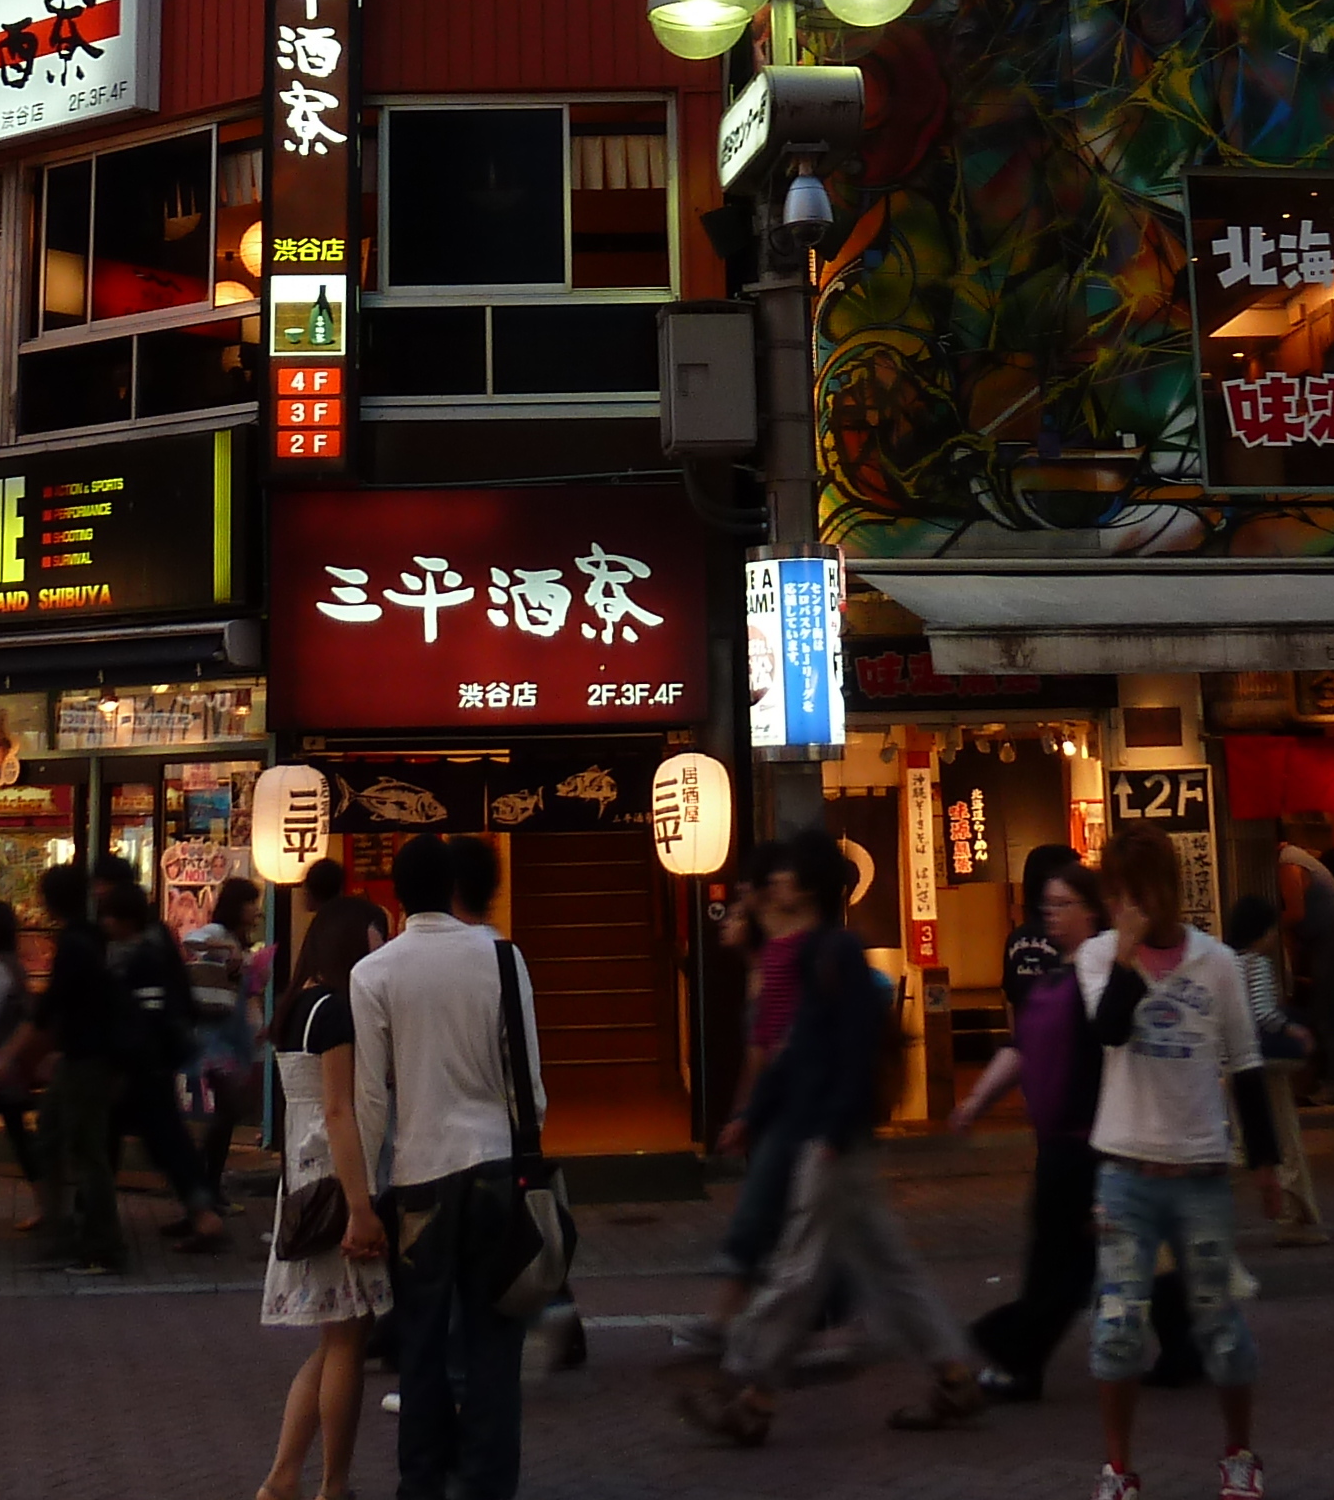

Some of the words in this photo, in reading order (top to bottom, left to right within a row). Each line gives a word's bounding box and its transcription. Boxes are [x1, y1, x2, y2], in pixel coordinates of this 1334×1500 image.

[0, 102, 45, 130] 渋谷店
[68, 80, 128, 114] 2F.3F.4F
[273, 238, 346, 262] 渋谷店
[38, 583, 113, 611] SHIBUYA
[315, 542, 664, 644] 三平酒寮
[457, 682, 538, 708] 渋谷店
[586, 682, 684, 707] 2F.3F.4F
[652, 777, 683, 856] 三平
[680, 766, 701, 825] 居酒屋
[971, 788, 988, 862] 北海道らーめん
[283, 788, 322, 864] 三平
